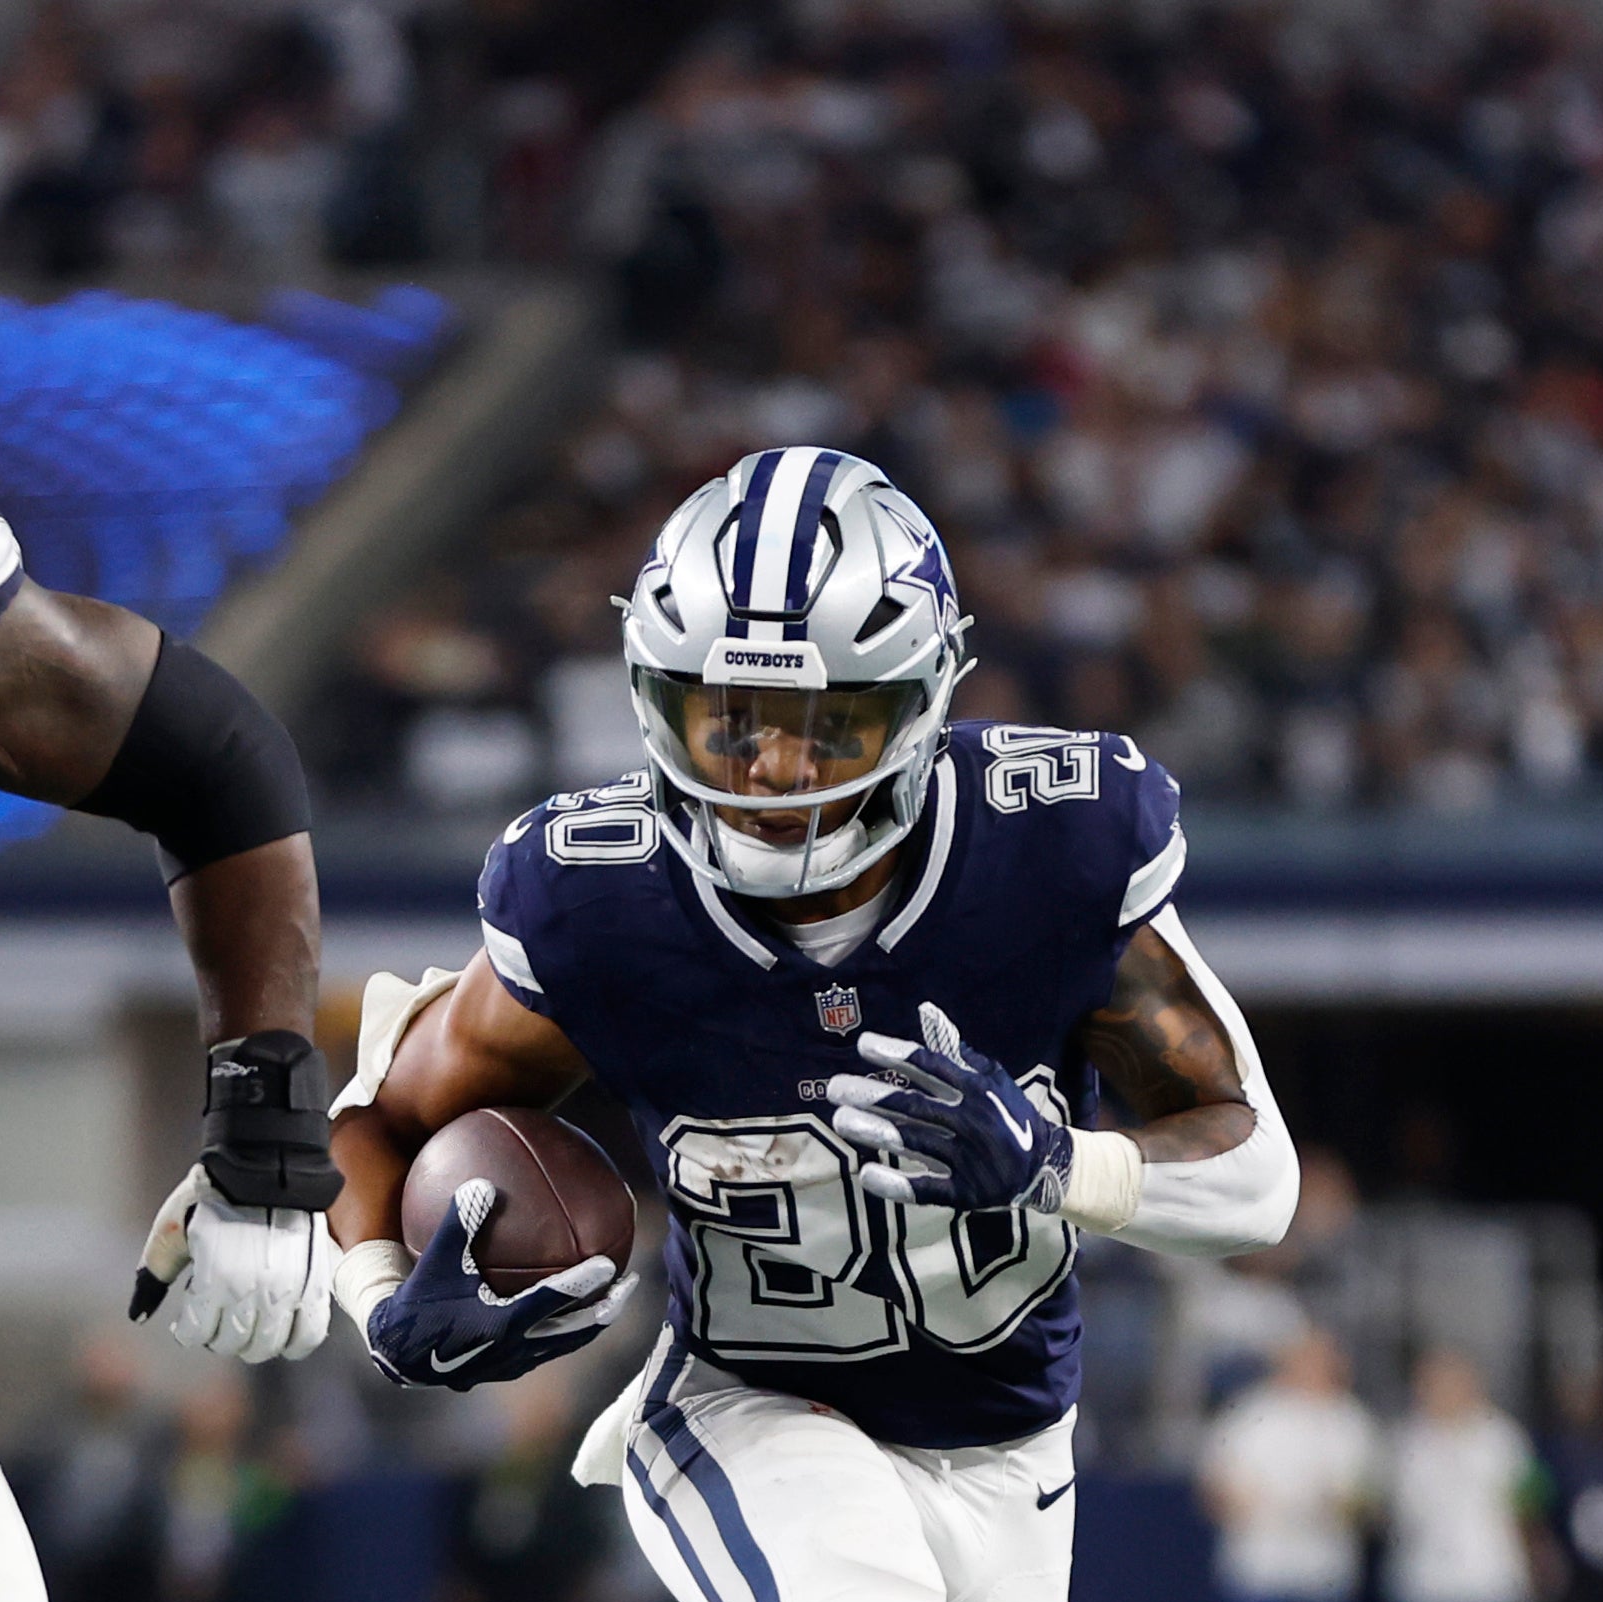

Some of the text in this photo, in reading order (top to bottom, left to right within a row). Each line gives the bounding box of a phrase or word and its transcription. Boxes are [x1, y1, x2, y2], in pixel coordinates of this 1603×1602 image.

[724, 650, 805, 669] COWBOYS
[825, 1007, 855, 1027] NFL
[658, 1063, 1080, 1363] 20
